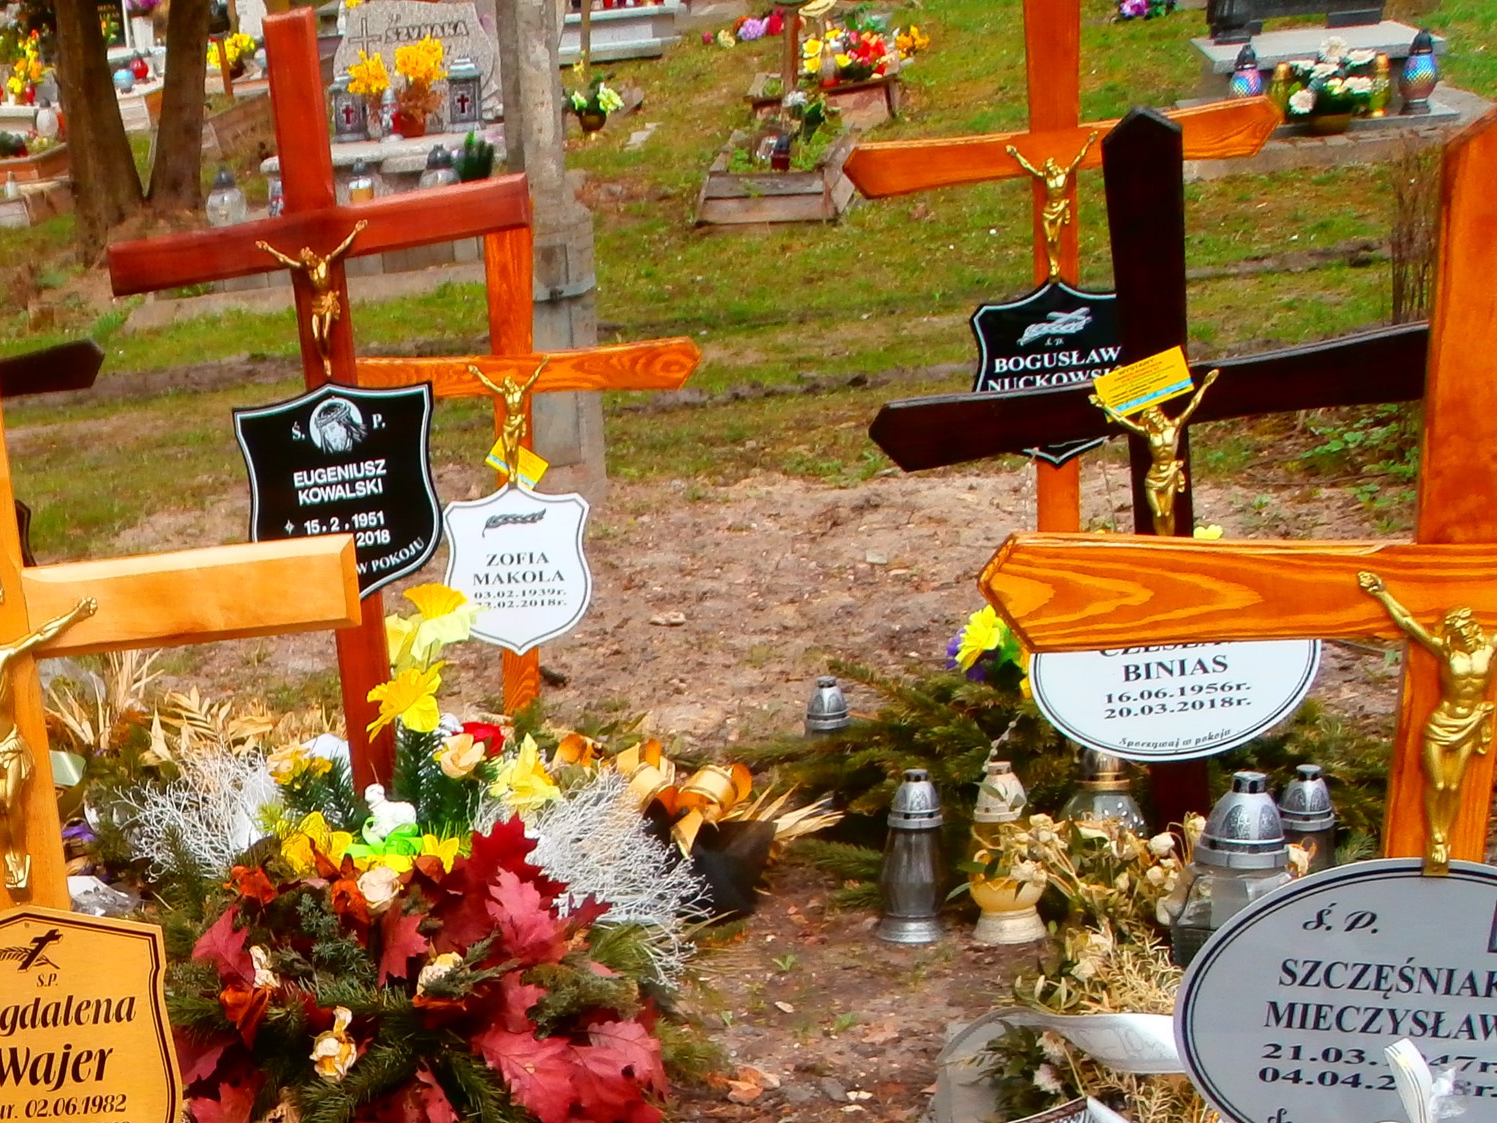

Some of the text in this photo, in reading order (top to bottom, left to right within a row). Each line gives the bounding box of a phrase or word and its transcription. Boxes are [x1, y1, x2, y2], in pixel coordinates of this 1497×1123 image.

[994, 346, 1122, 373] BOGUSŁAW
[372, 414, 386, 429] P.
[293, 459, 387, 488] EUGENIUSZ
[298, 478, 383, 506] KOWALSKI
[373, 537, 425, 572] POKOJU
[486, 552, 549, 567] ZOFIA
[473, 570, 565, 586] MAKOLA
[1122, 655, 1228, 682] BINIAS
[1105, 680, 1252, 704] 16.06.1956r.
[1104, 695, 1252, 720] 20.03.2018r.
[25, 1094, 127, 1118] 02.06.1982
